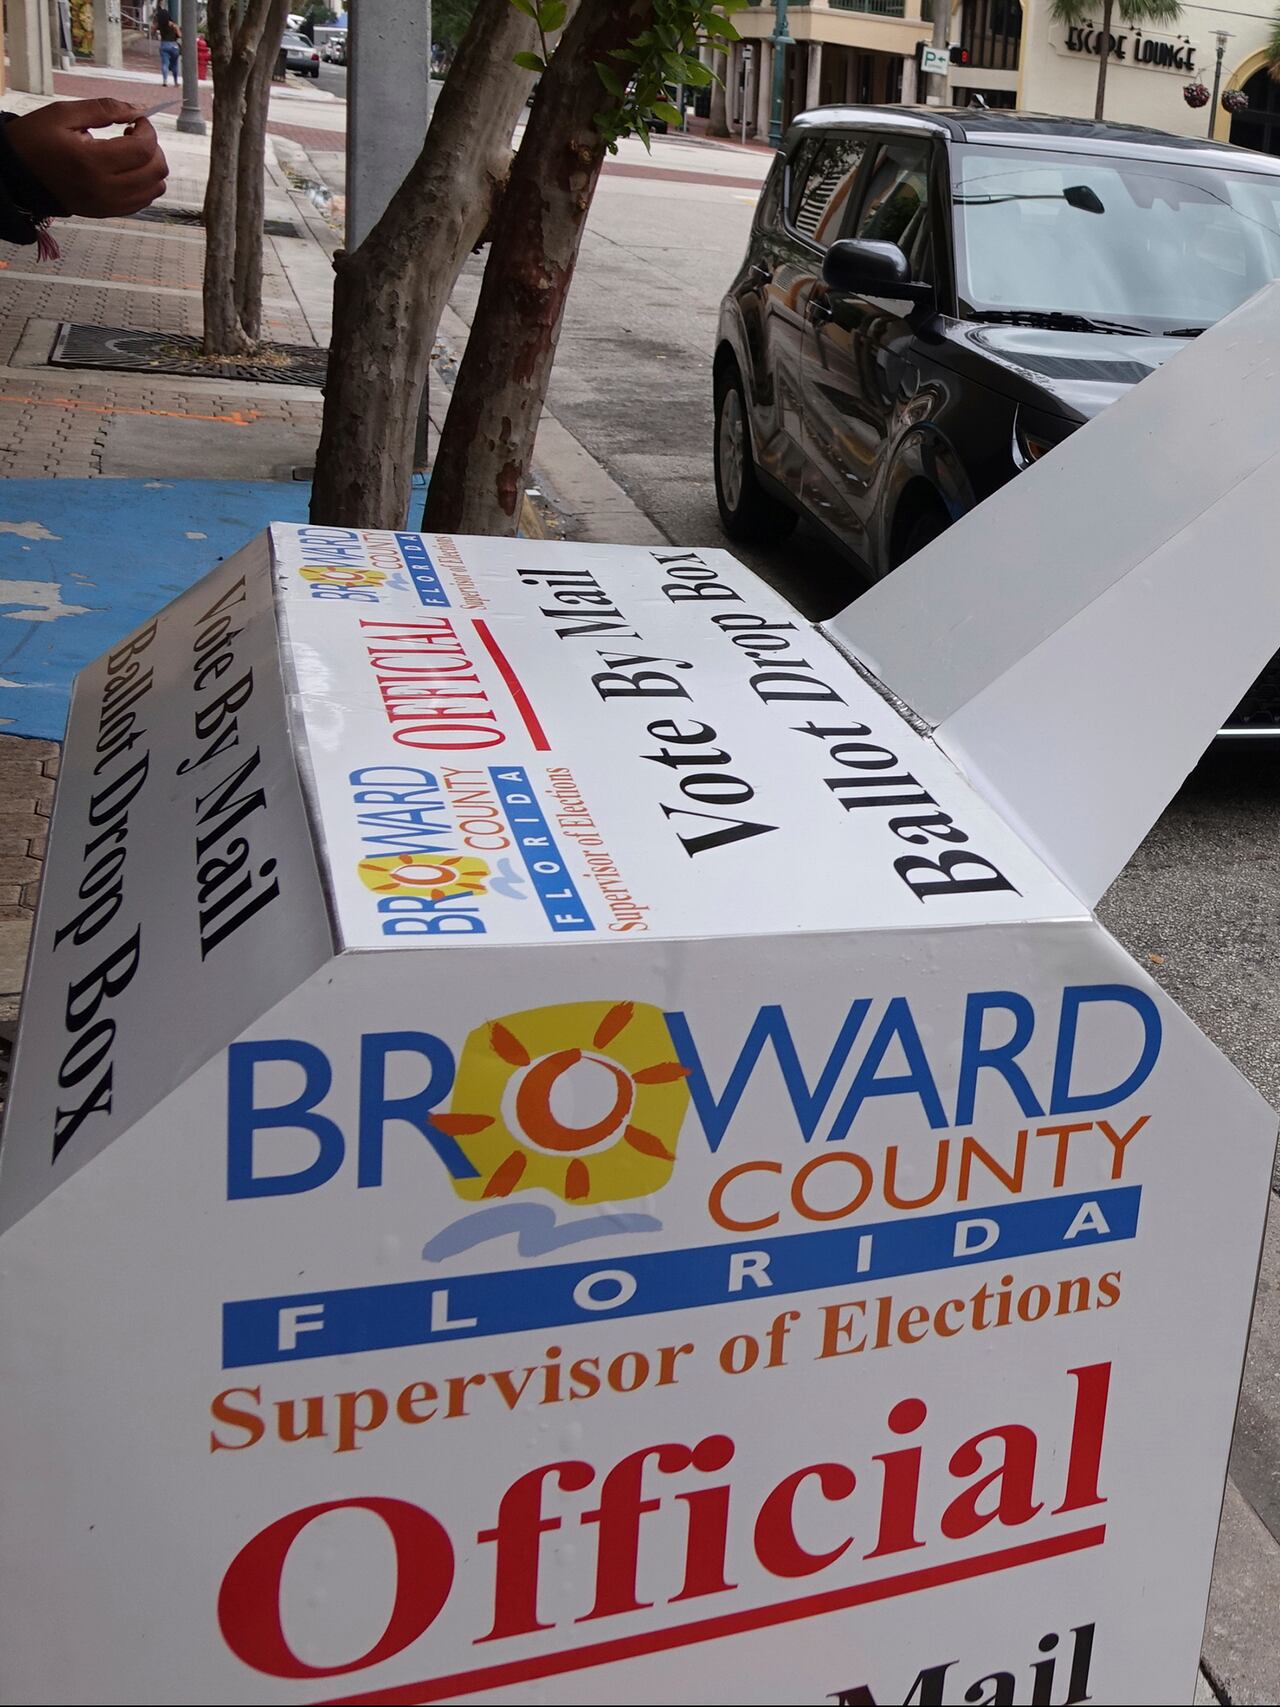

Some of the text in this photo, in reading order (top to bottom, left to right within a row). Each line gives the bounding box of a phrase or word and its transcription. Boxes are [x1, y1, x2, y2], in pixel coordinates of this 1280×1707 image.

[924, 51, 936, 66] P
[1134, 38, 1196, 70] LOUNGE
[297, 527, 380, 603] BROWARD
[360, 531, 404, 570] COUNTY
[400, 534, 446, 605] FLORIDA
[449, 573, 490, 611] Supervisor
[358, 615, 506, 750] OFFICIAL
[516, 568, 780, 858] Vote By Mail
[649, 551, 1023, 904] Ballot Drop Box
[177, 575, 281, 963] Vote By Mail
[440, 766, 511, 851] COUNTY
[51, 619, 158, 1166] Ballot Drop Box
[349, 766, 488, 935] BROWARD
[497, 770, 585, 925] FLORIDA
[545, 767, 650, 932] Supervisor of Elections
[227, 984, 1162, 1201] BROWARD
[708, 1115, 1152, 1232] COUNTY
[278, 1201, 1111, 1351] FLORIDA
[209, 1270, 1122, 1455] Supervisor of Elections
[217, 1361, 1113, 1680] Official
